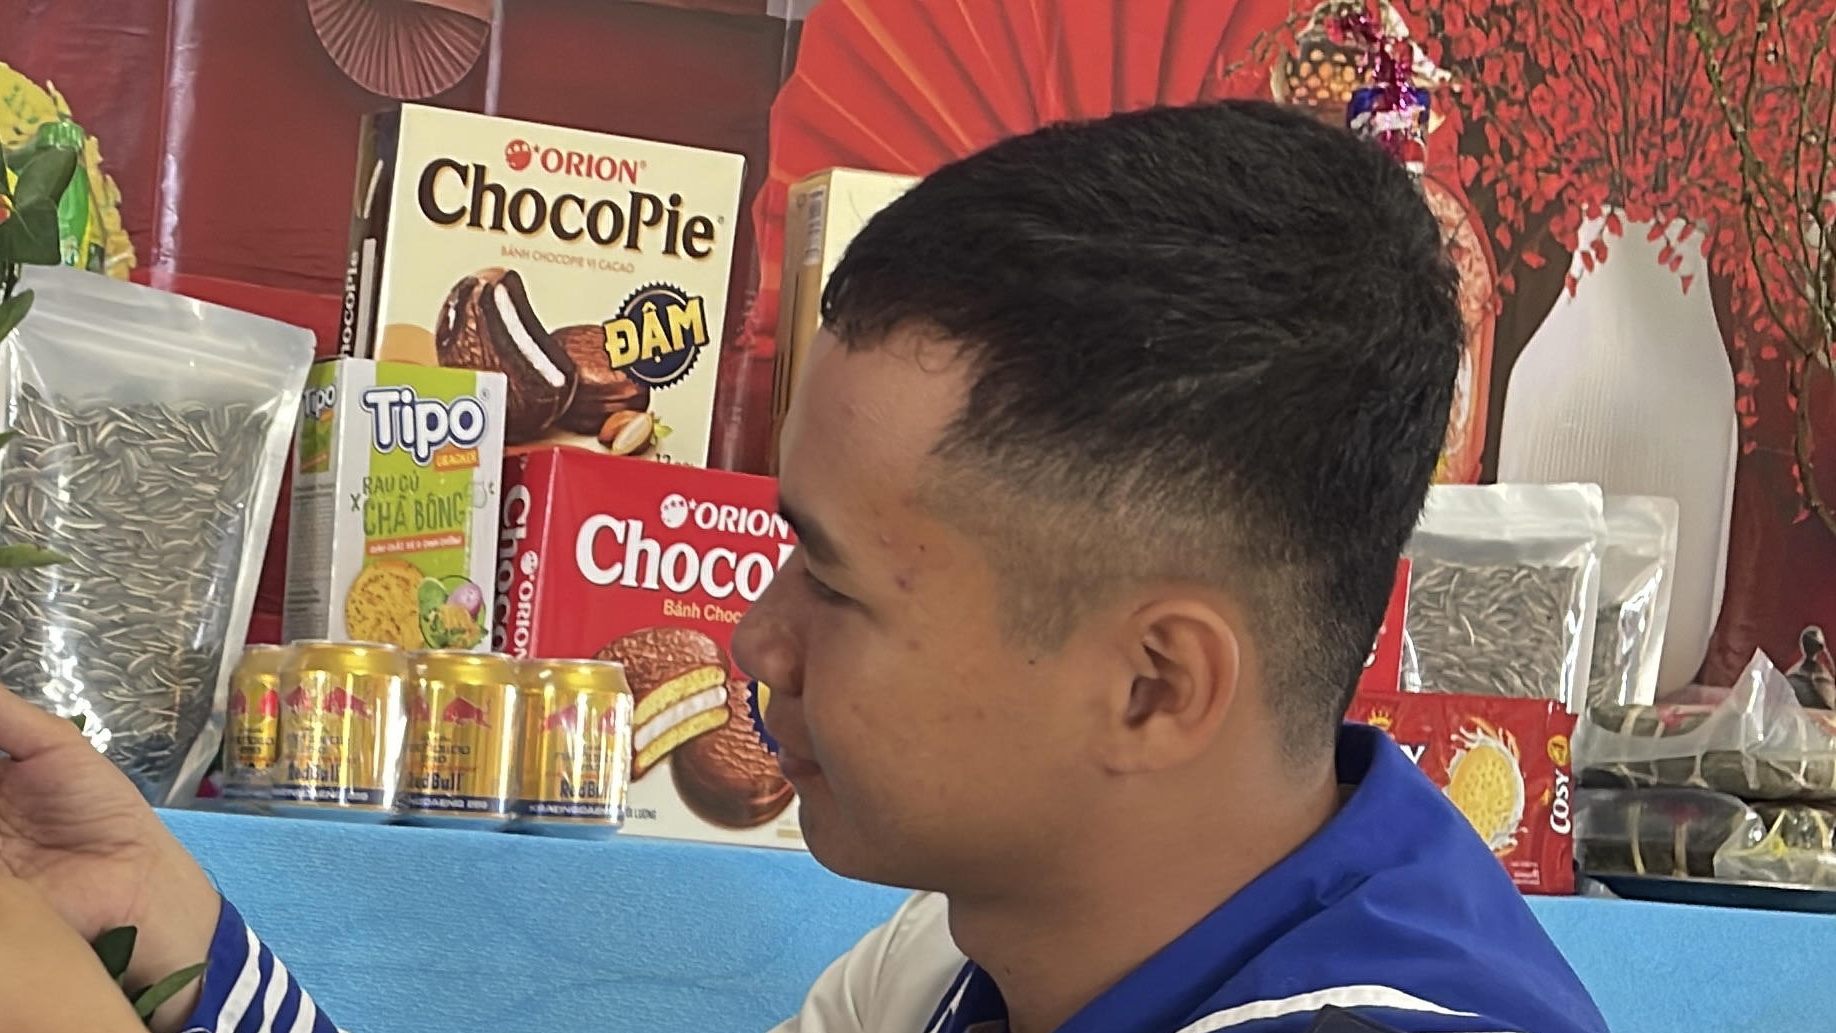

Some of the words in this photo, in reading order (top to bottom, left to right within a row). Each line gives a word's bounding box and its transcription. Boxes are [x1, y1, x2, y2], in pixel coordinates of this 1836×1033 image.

[540, 147, 638, 184] ORION
[417, 158, 715, 258] ChocoPie
[604, 297, 708, 369] ĐẬM
[363, 386, 487, 464] Tipo
[363, 475, 395, 495] RAU
[414, 491, 466, 531] BÔNG
[694, 501, 789, 539] ORION
[664, 600, 700, 619] Bánh
[1550, 769, 1572, 835] COSY
